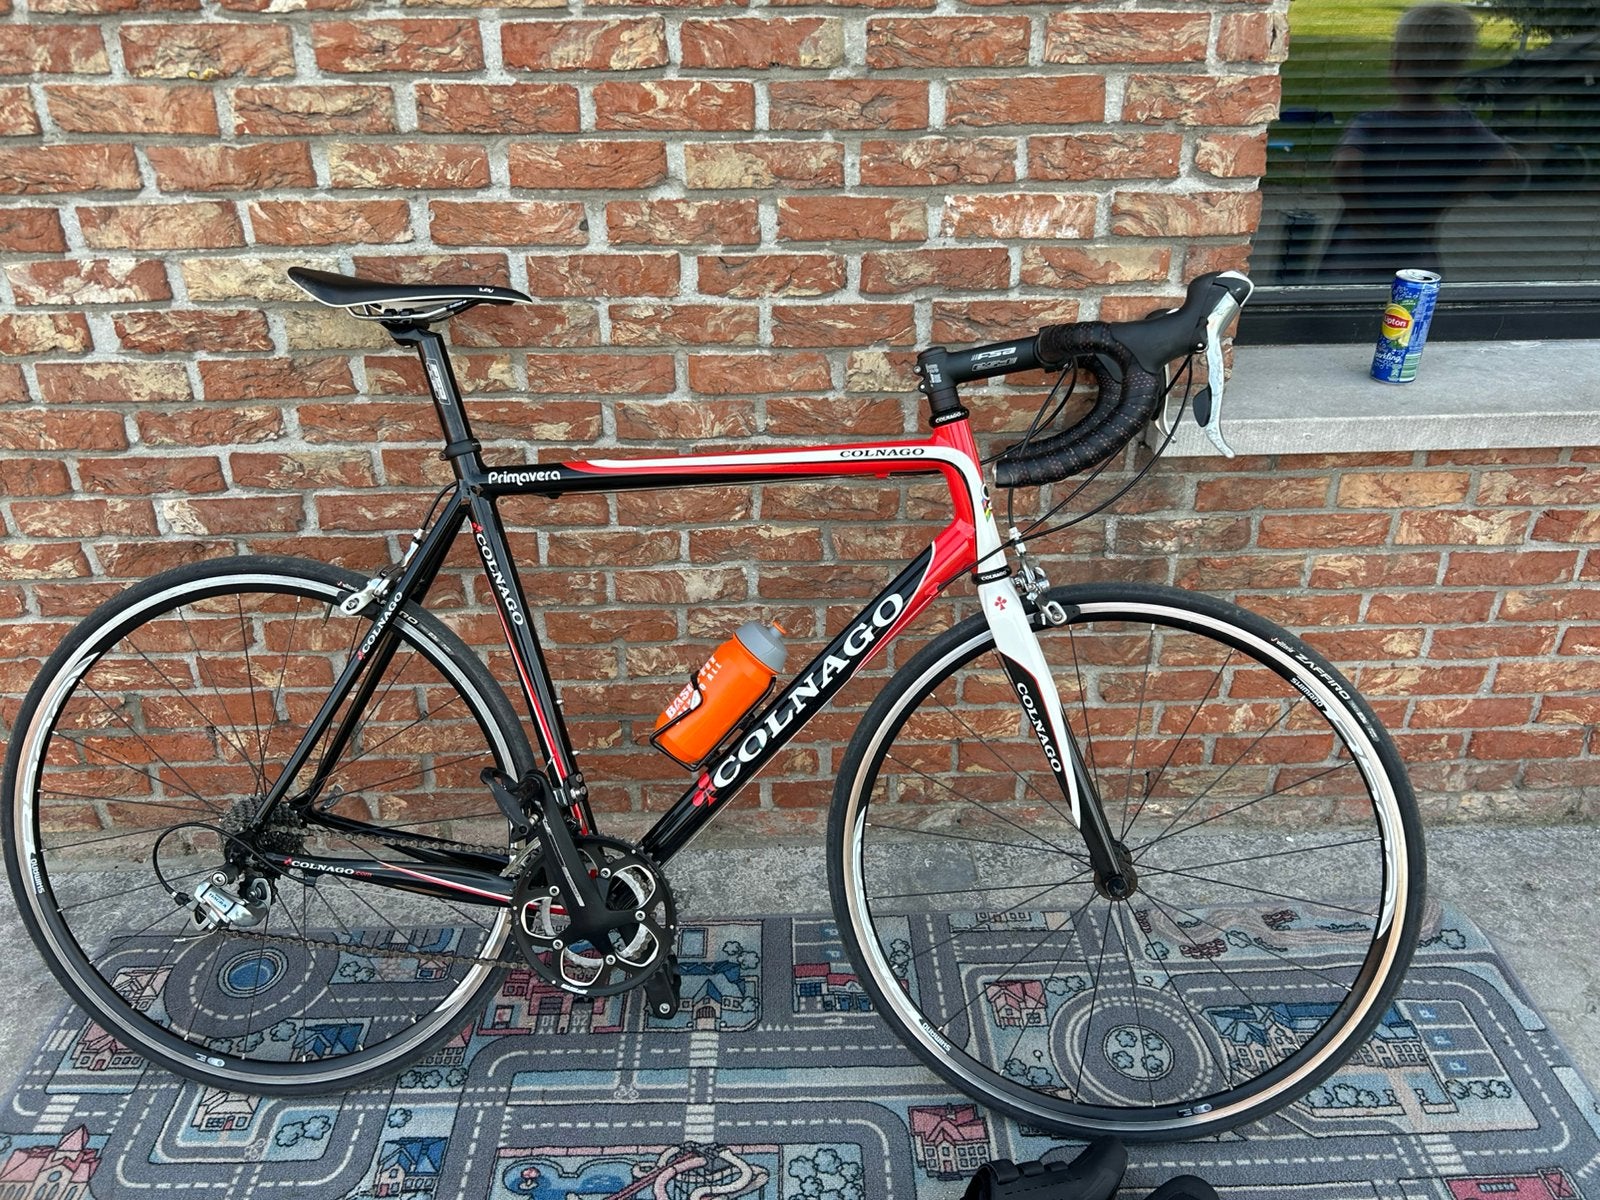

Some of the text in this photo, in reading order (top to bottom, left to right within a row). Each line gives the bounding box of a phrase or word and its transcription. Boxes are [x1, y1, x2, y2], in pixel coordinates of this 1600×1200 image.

[840, 447, 925, 458] COLNAGO
[488, 470, 561, 487] Primavera
[476, 533, 524, 626] COLNAGO
[361, 591, 403, 654] COLNAGO
[713, 593, 904, 788] COLNAGO
[1290, 677, 1324, 708] SHIMANO
[1295, 653, 1351, 700] ZAFFIRO
[1016, 682, 1063, 773] COLNAGO
[31, 858, 46, 894] SHIMANO
[922, 1021, 952, 1053] SHIMANO
